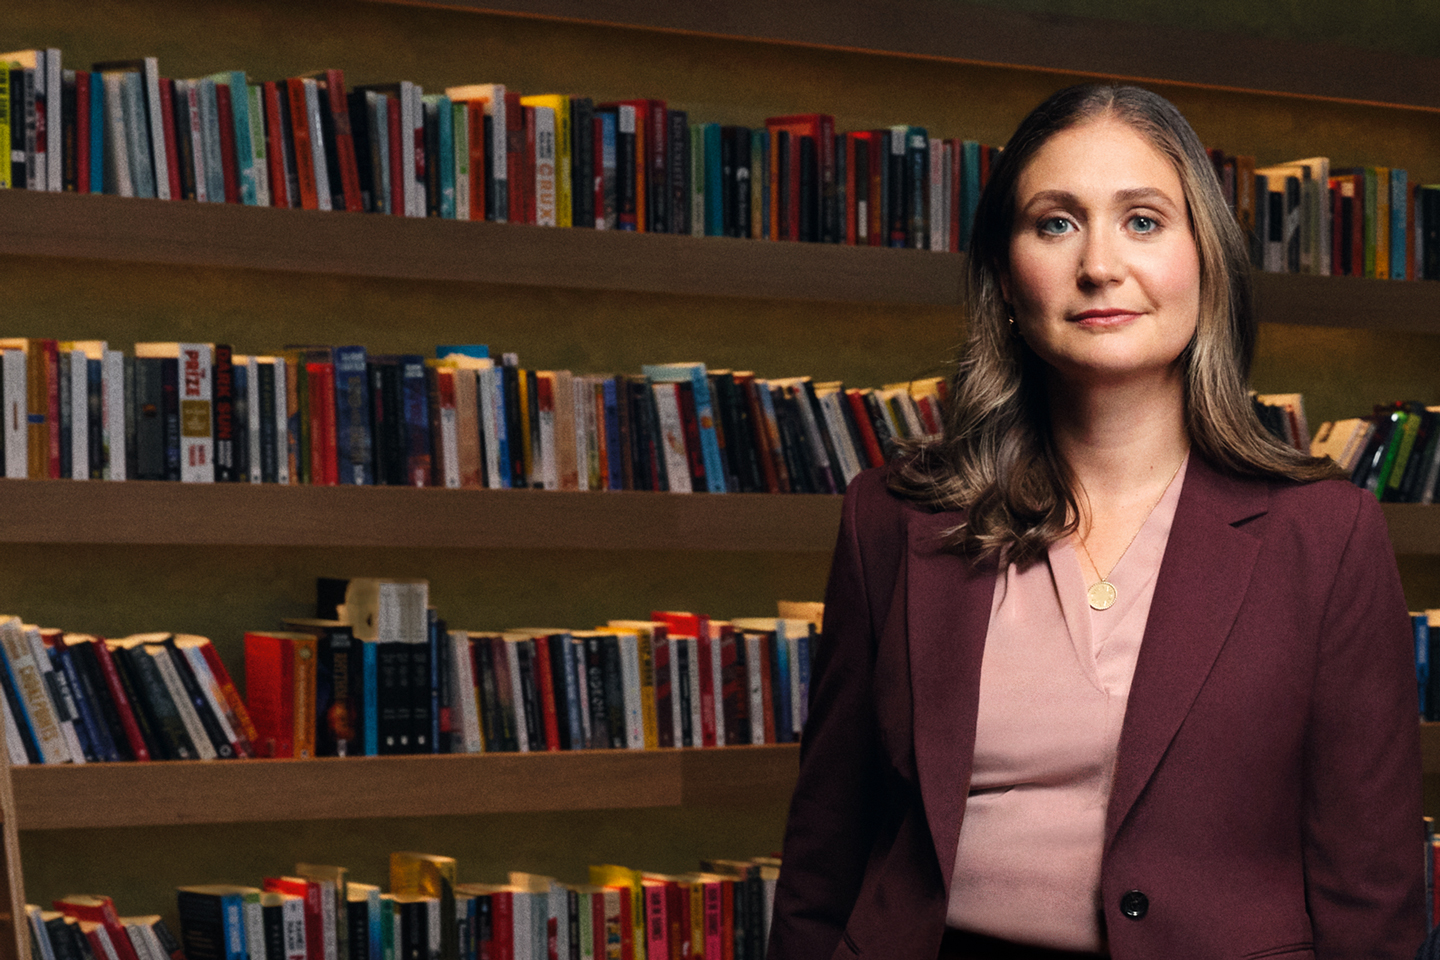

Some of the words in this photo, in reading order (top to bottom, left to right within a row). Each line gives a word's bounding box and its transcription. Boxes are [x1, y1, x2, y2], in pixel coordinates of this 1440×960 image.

[539, 163, 553, 219] CRUX
[185, 350, 201, 396] PRIZE
[216, 347, 232, 398] DARK
[217, 401, 233, 439] SUN
